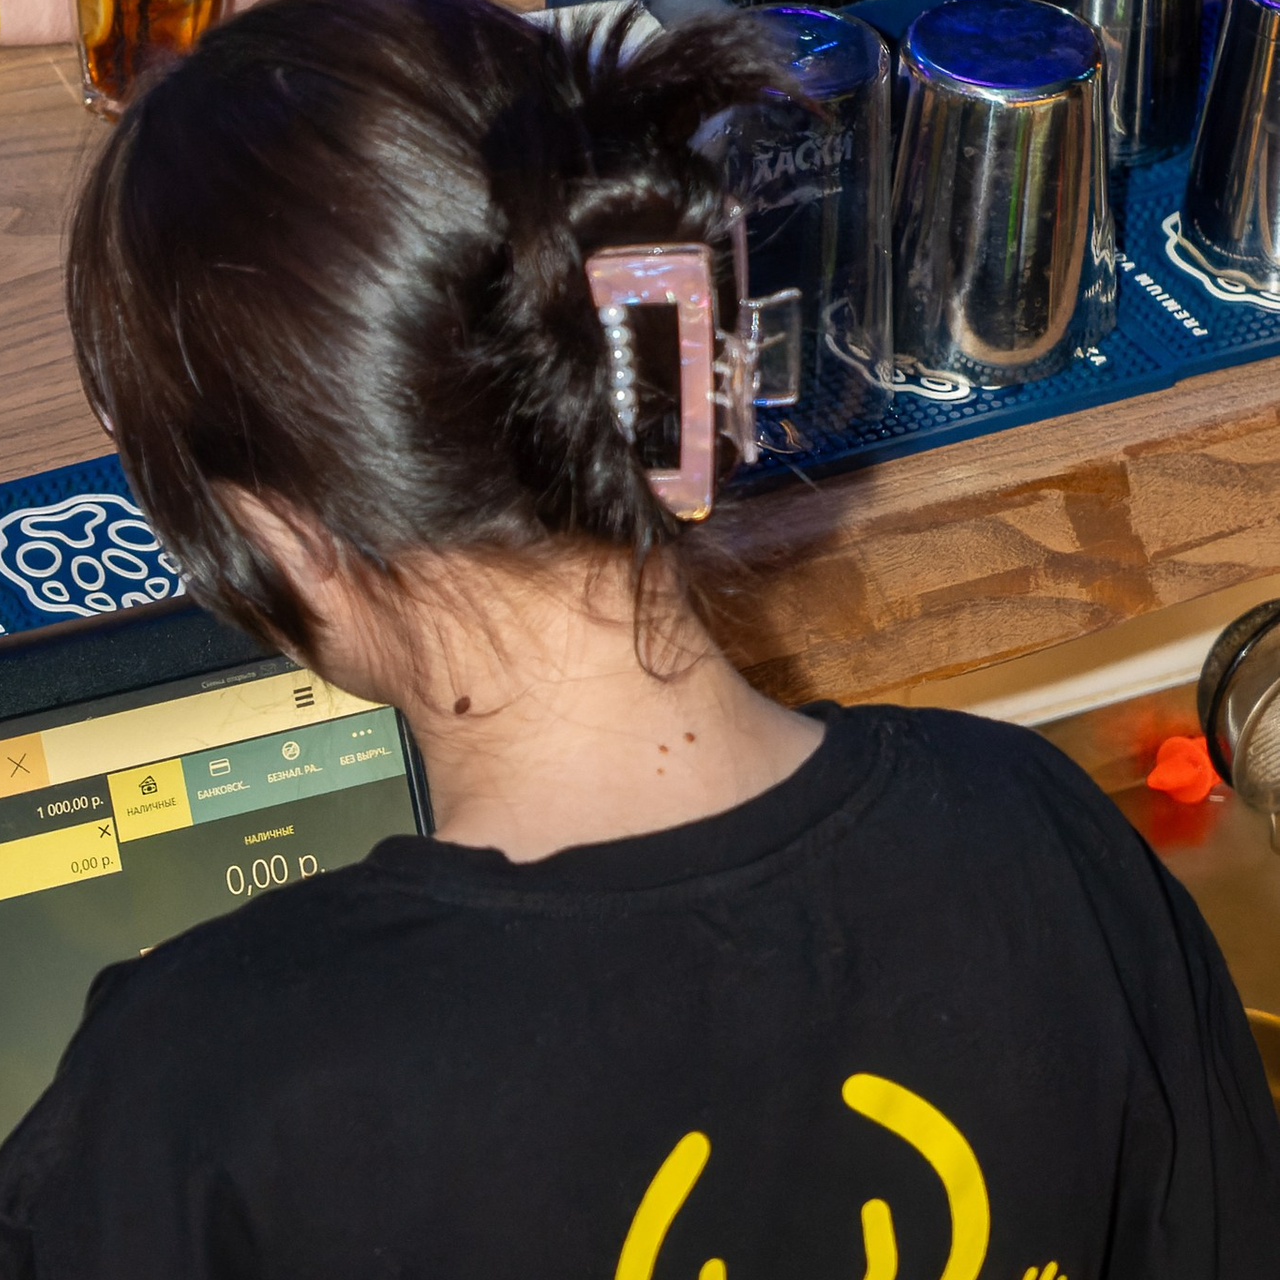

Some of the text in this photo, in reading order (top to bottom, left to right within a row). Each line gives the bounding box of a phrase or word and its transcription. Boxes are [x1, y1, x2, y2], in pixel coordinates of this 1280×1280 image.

[1135, 273, 1208, 336] PREMIUM
[340, 755, 355, 766] БЕЗ
[126, 797, 177, 816] НАЛИЧНЫЕ
[244, 824, 294, 846] НАЛИЧНЫЕ
[71, 857, 98, 875] 0,00
[226, 854, 289, 896] 0,00
